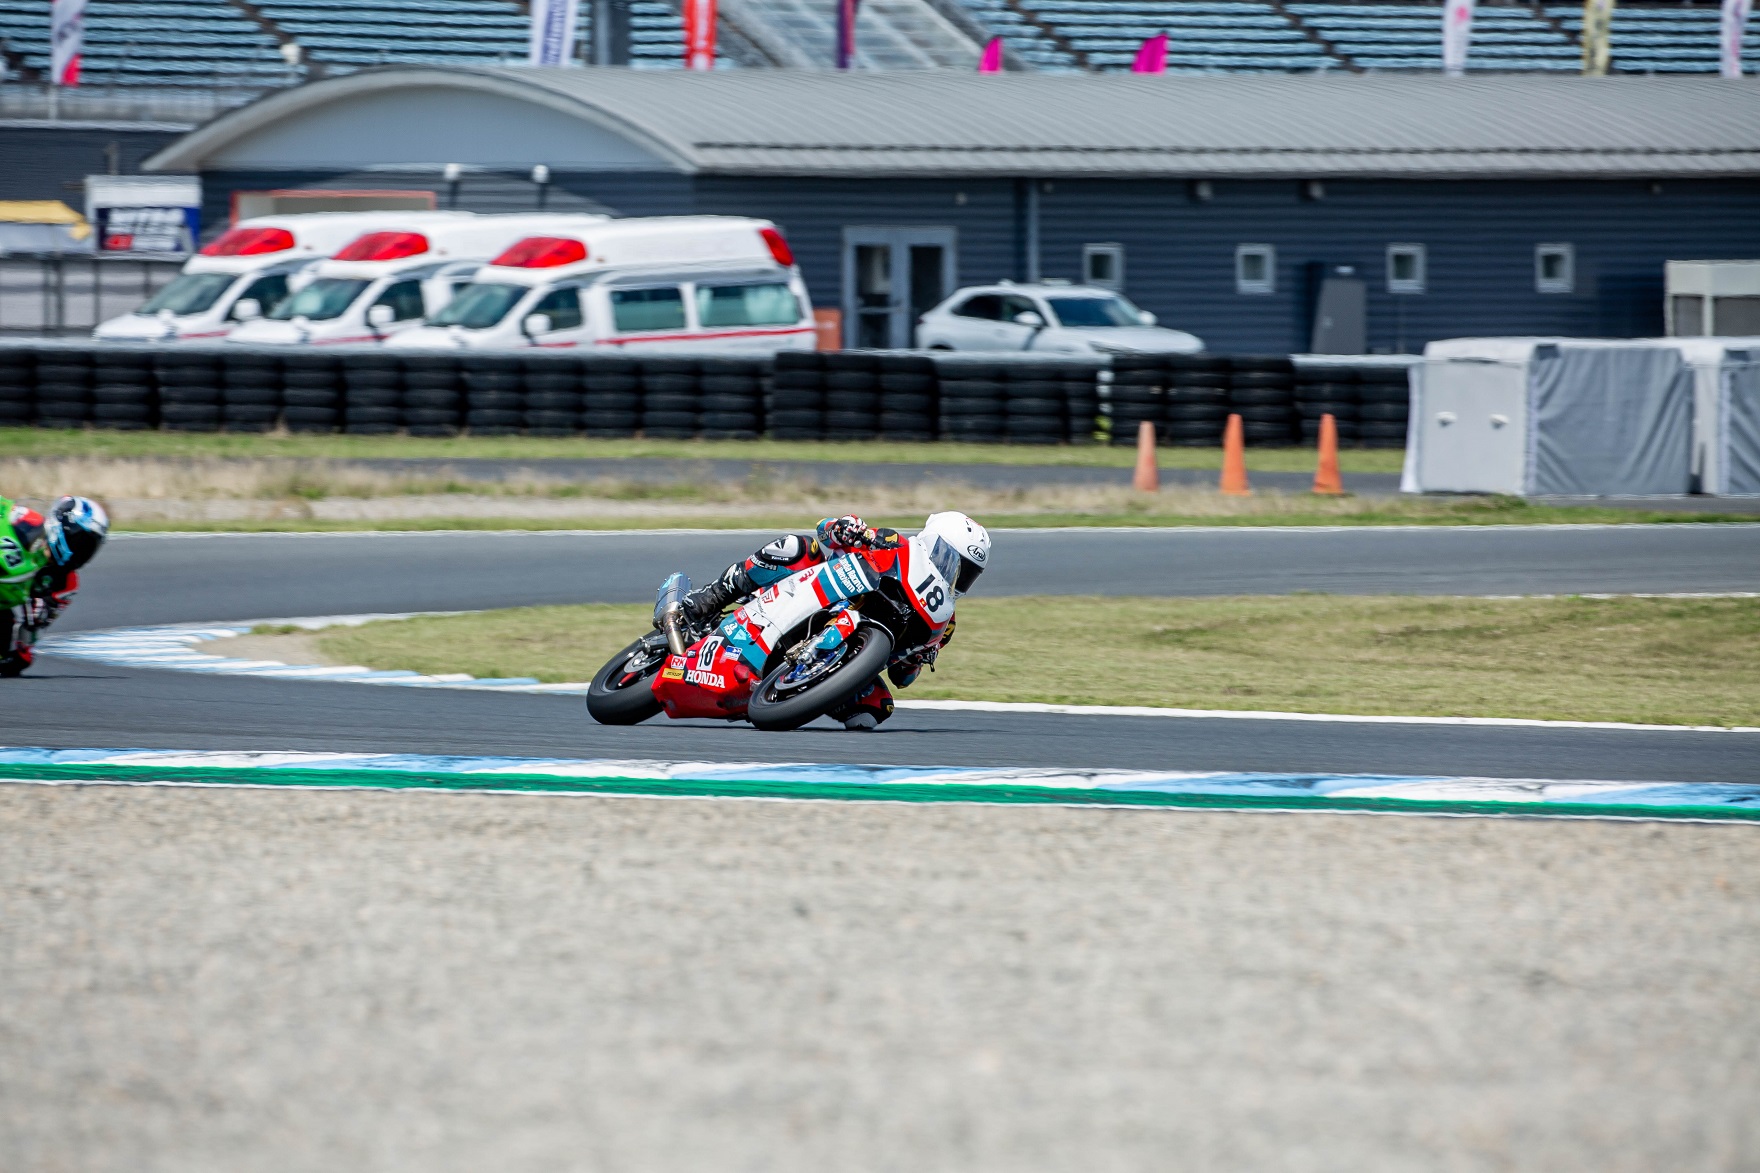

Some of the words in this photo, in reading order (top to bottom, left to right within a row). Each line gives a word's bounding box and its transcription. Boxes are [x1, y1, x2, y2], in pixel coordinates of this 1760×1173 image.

[915, 573, 945, 613] 18
[672, 657, 686, 667] RK
[700, 640, 719, 667] 18
[685, 669, 726, 689] HONDA
